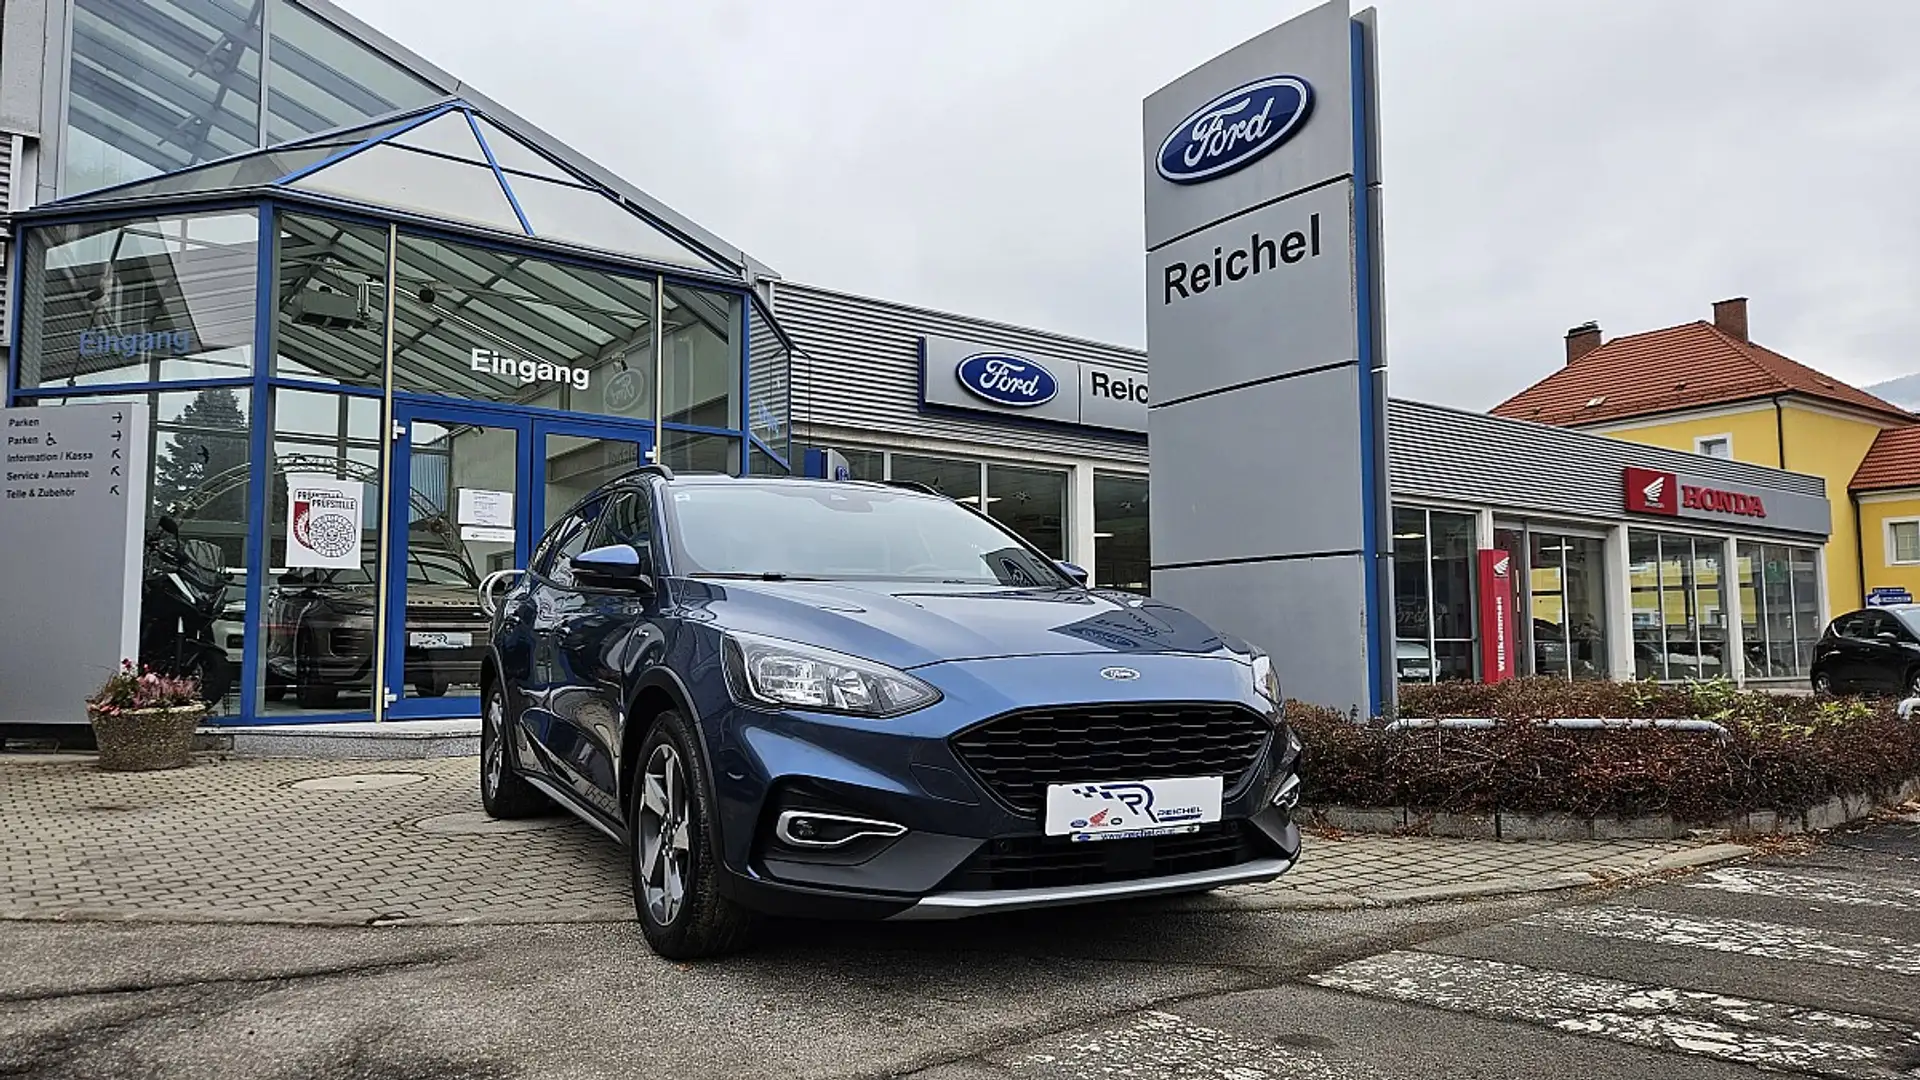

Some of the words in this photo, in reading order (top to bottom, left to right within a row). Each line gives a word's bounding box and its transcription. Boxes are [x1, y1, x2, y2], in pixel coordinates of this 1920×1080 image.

[1184, 97, 1275, 167] Ford
[1164, 213, 1320, 305] Reichel
[80, 330, 190, 359] Eingang
[470, 347, 591, 391] Eingang
[979, 359, 1041, 397] Ford
[8, 418, 40, 428] Parken
[7, 436, 39, 446] Parken
[7, 453, 58, 463] Information
[65, 451, 94, 461] Kassa
[6, 471, 40, 482] Service
[46, 469, 90, 480] Annahme
[6, 488, 27, 500] Teile
[28, 488, 36, 499] &
[1681, 485, 1767, 519] HONDA
[1495, 596, 1506, 673] Willkommen
